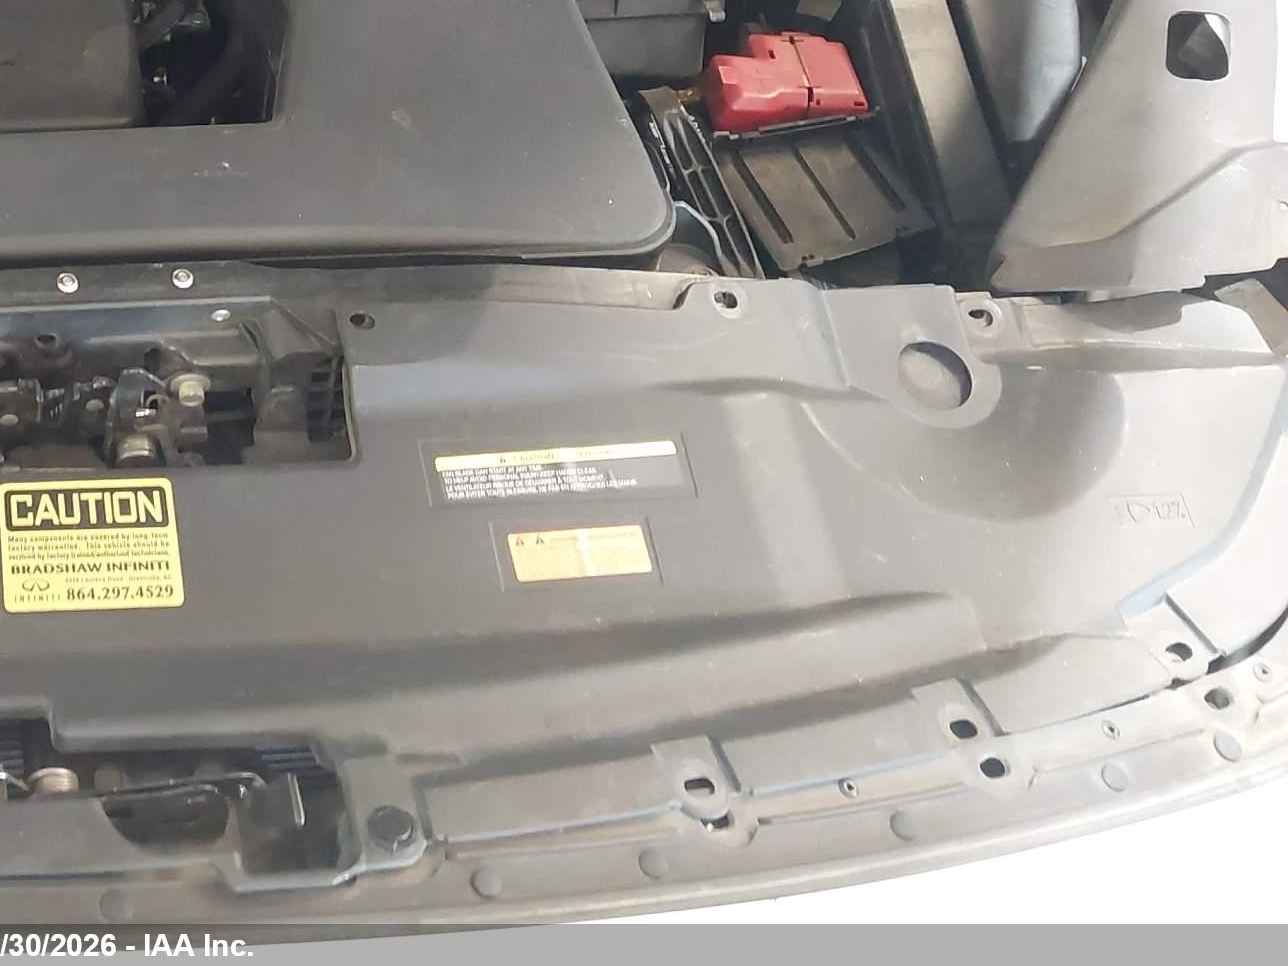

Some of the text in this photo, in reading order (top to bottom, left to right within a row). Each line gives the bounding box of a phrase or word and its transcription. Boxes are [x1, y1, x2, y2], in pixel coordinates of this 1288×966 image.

[10, 491, 163, 527] CAUTION
[11, 560, 170, 575] BRADSHAW INFINITI
[14, 585, 174, 603] INFINITI 864.297.4529
